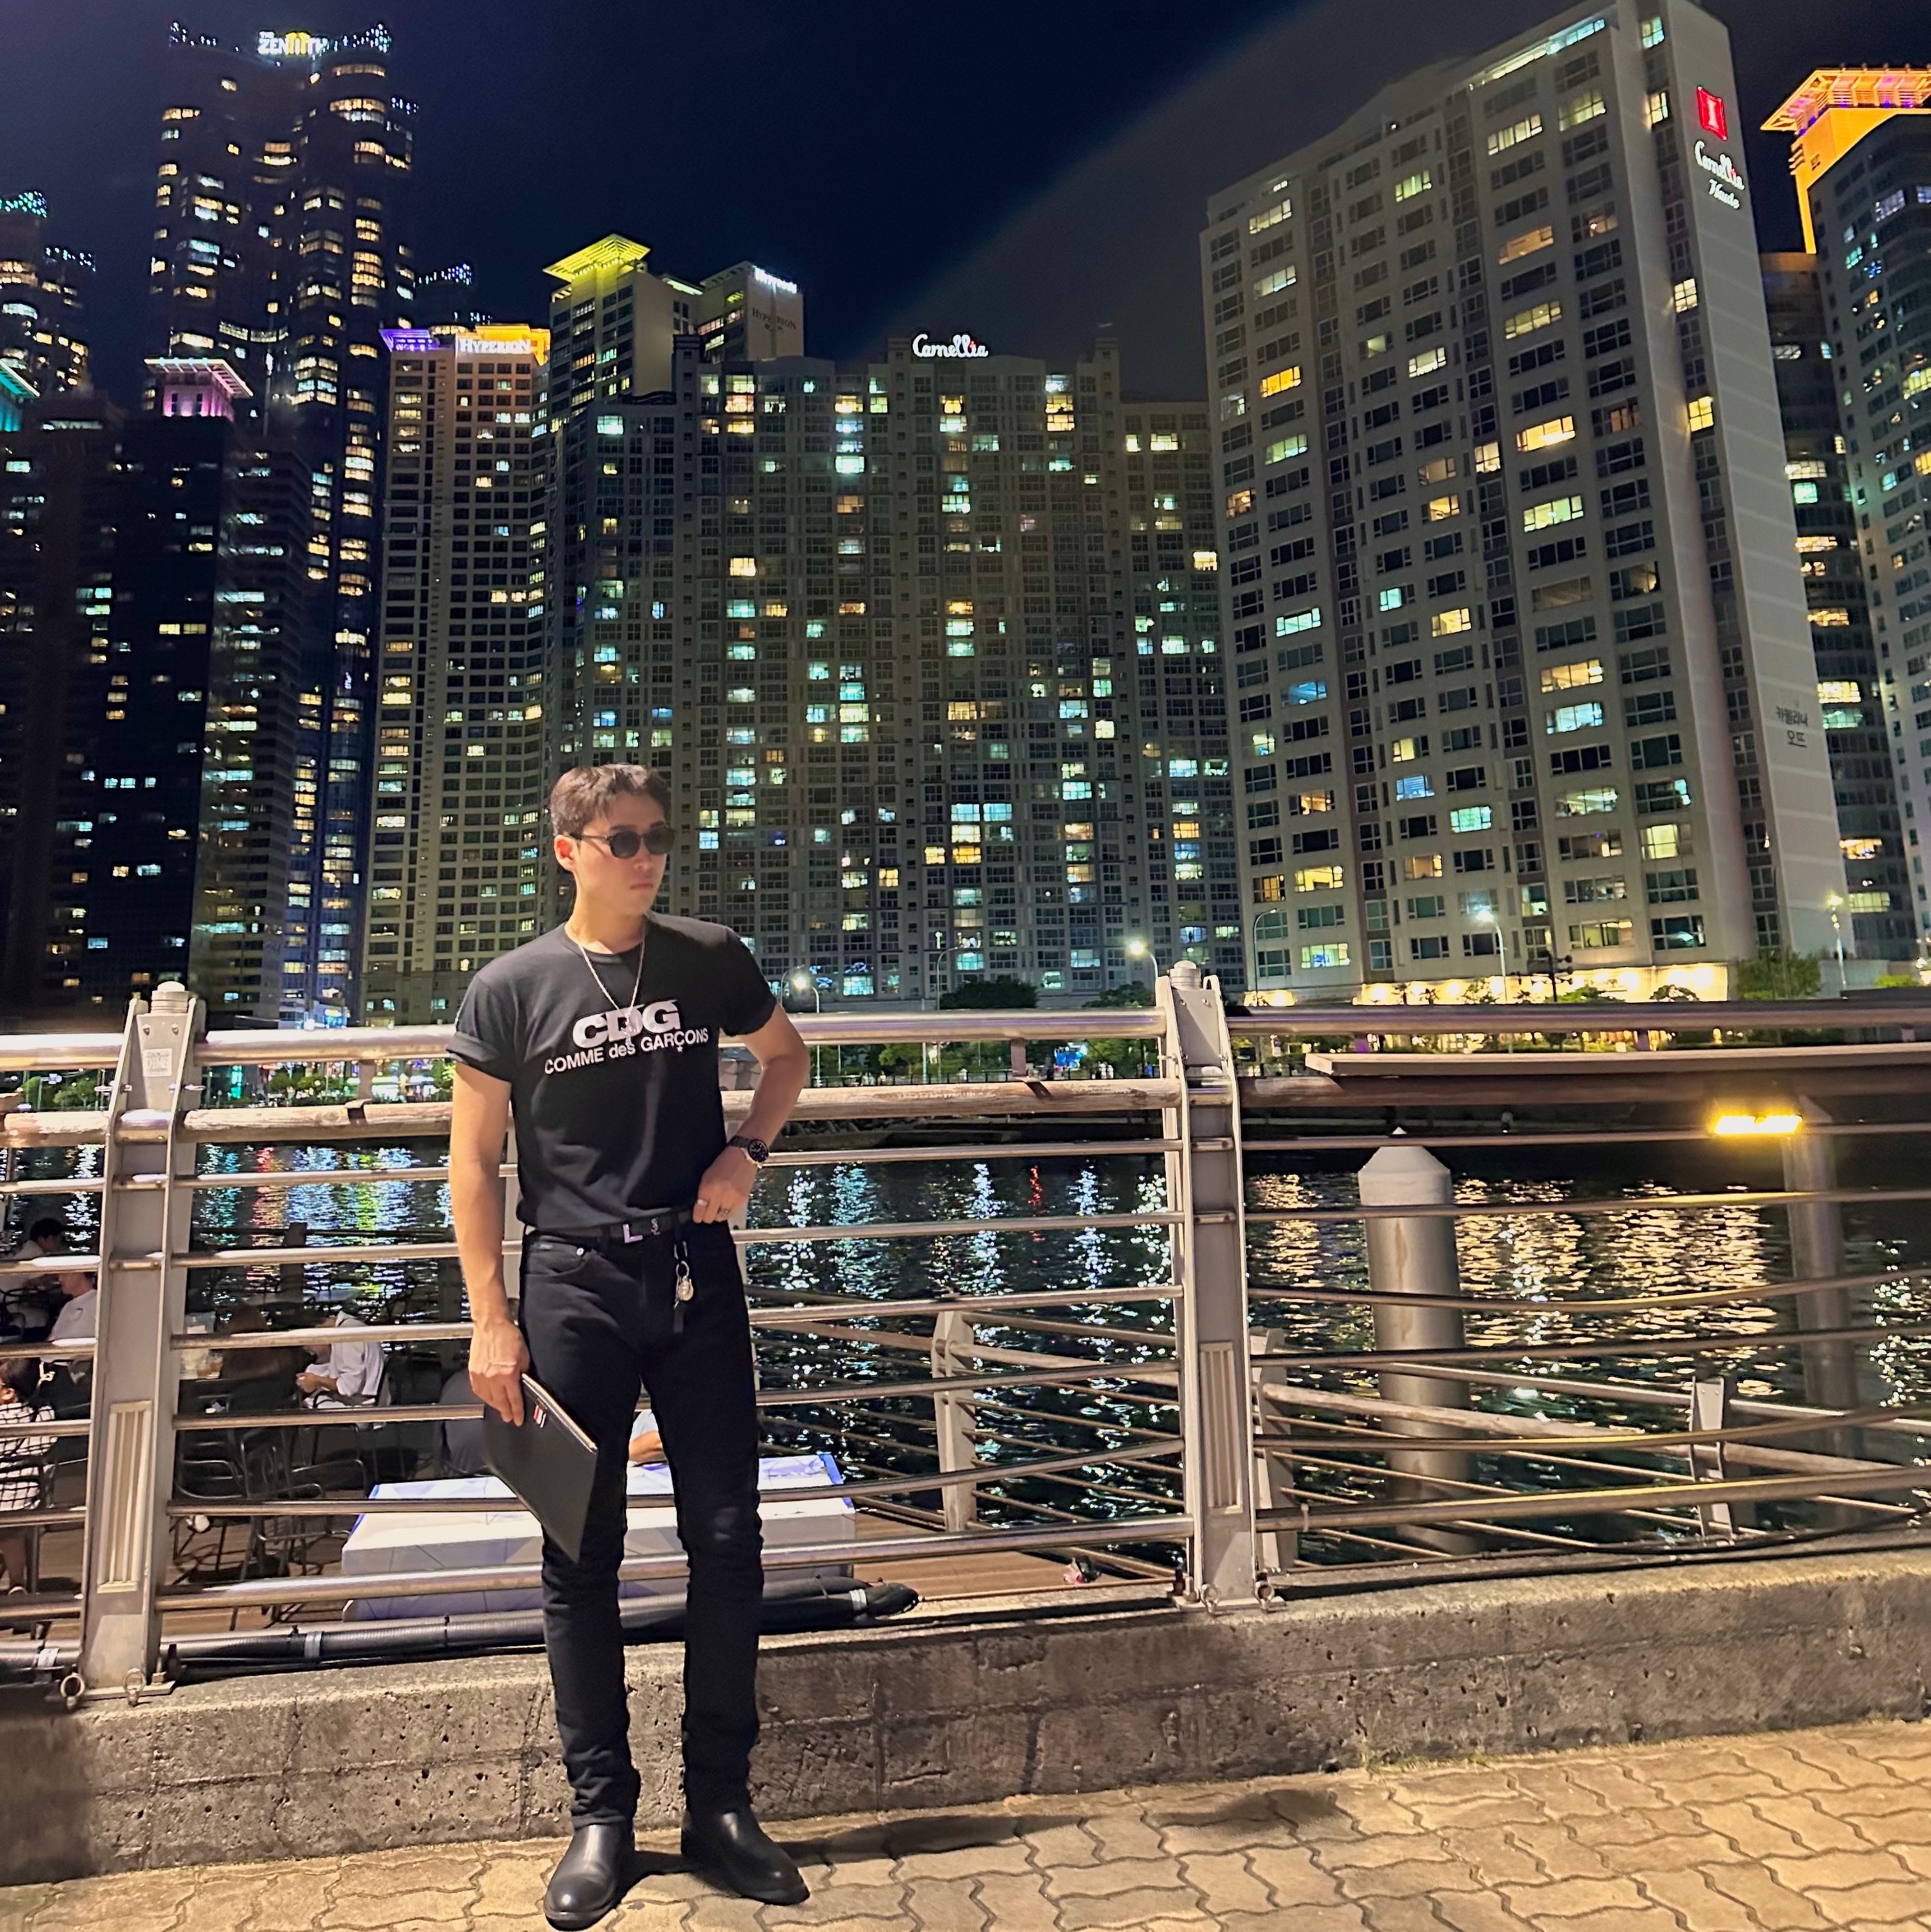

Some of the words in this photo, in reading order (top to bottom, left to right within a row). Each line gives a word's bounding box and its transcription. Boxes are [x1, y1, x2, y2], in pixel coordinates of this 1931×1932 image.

[912, 334, 989, 358] Camellia
[572, 999, 681, 1048] CDG
[545, 1047, 604, 1075] COMME
[609, 1042, 636, 1059] des
[641, 1027, 709, 1053] GARÇONS
